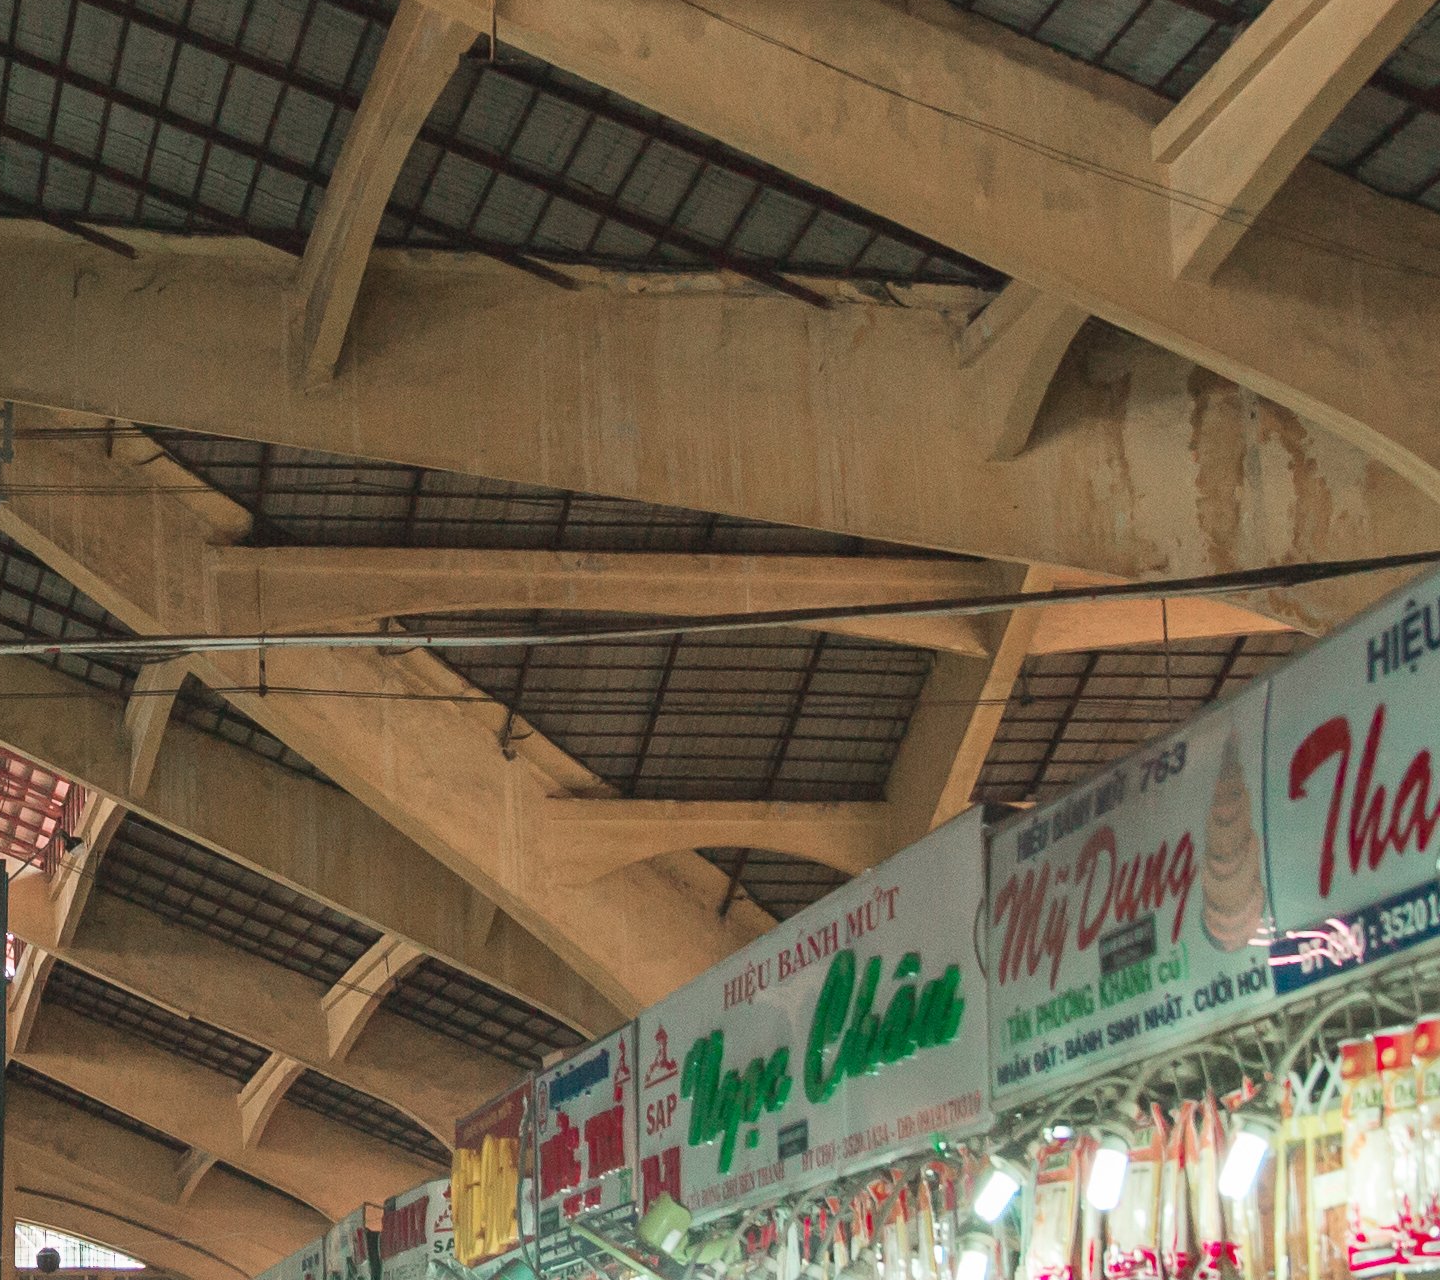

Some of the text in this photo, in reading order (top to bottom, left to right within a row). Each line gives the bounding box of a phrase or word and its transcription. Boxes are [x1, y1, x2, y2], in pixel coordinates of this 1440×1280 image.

[1140, 739, 1188, 794] 763
[723, 884, 900, 1011] HIỆU BÁNH MỨT
[992, 862, 1069, 992] Mỹ
[1076, 825, 1197, 952] Dung
[680, 1028, 792, 1175] Ngọc
